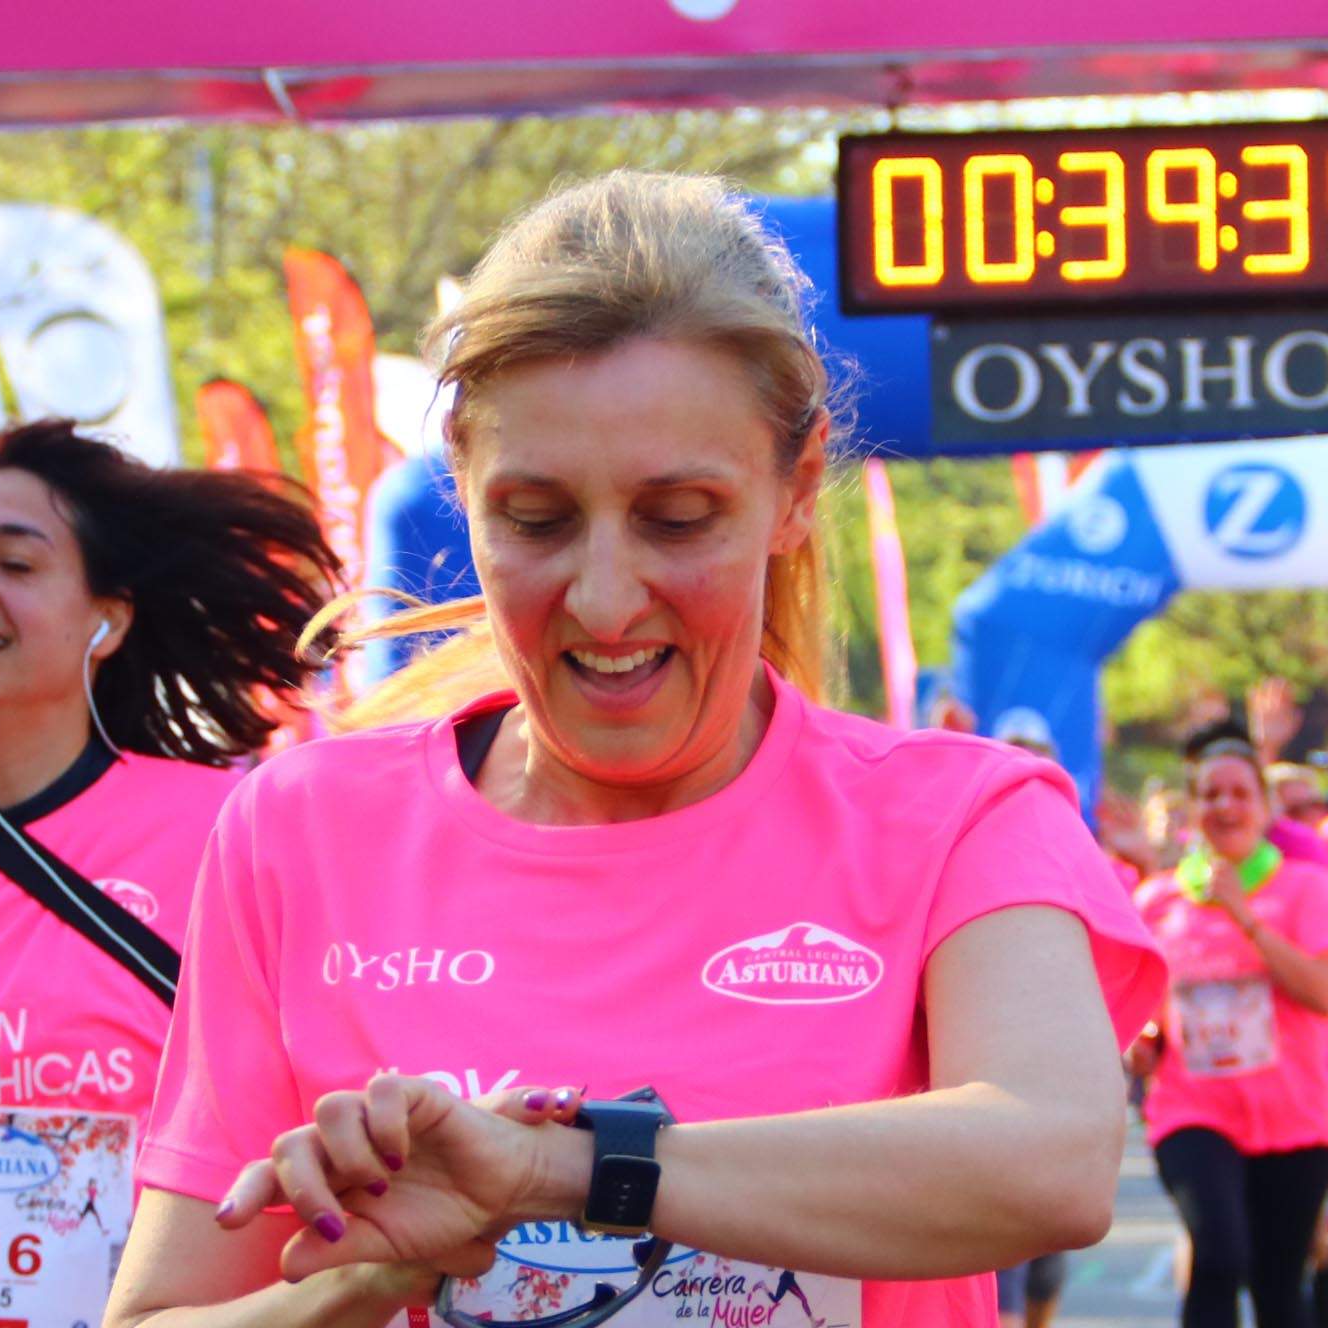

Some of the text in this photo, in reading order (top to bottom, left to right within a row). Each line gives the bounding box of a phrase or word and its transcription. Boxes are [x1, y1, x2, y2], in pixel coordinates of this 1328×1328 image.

[322, 940, 496, 991] OYSHO
[715, 957, 871, 986] ASTURIANA
[651, 1269, 747, 1298] Carrera
[676, 1300, 693, 1319] de
[698, 1301, 710, 1318] la
